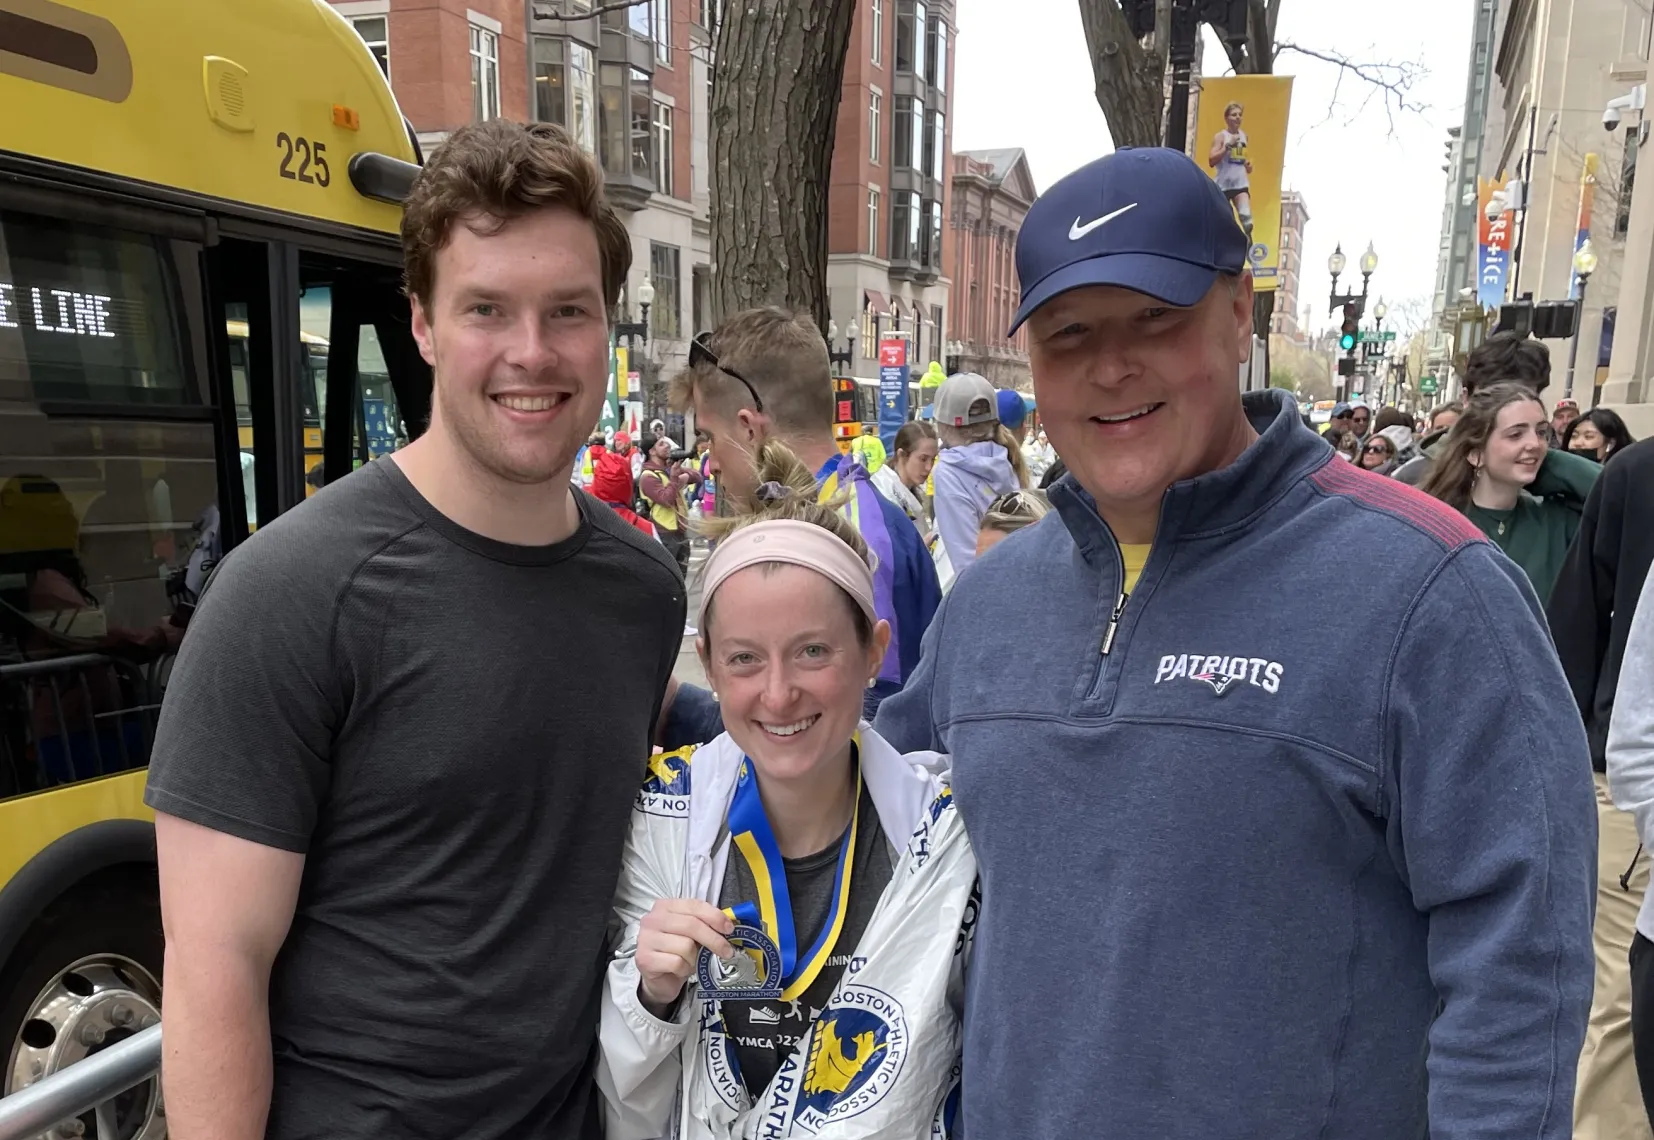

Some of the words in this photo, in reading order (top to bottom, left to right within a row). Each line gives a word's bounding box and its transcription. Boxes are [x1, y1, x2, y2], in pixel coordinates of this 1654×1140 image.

[277, 131, 330, 188] 225
[31, 287, 116, 337] LINE
[1154, 653, 1285, 694] PATRIOTS
[699, 948, 712, 988] BOSTON
[751, 932, 780, 988] ASSOCIATION
[711, 991, 740, 999] BOSTON
[831, 991, 896, 1019] BOSTON
[736, 1036, 775, 1050] YMCA
